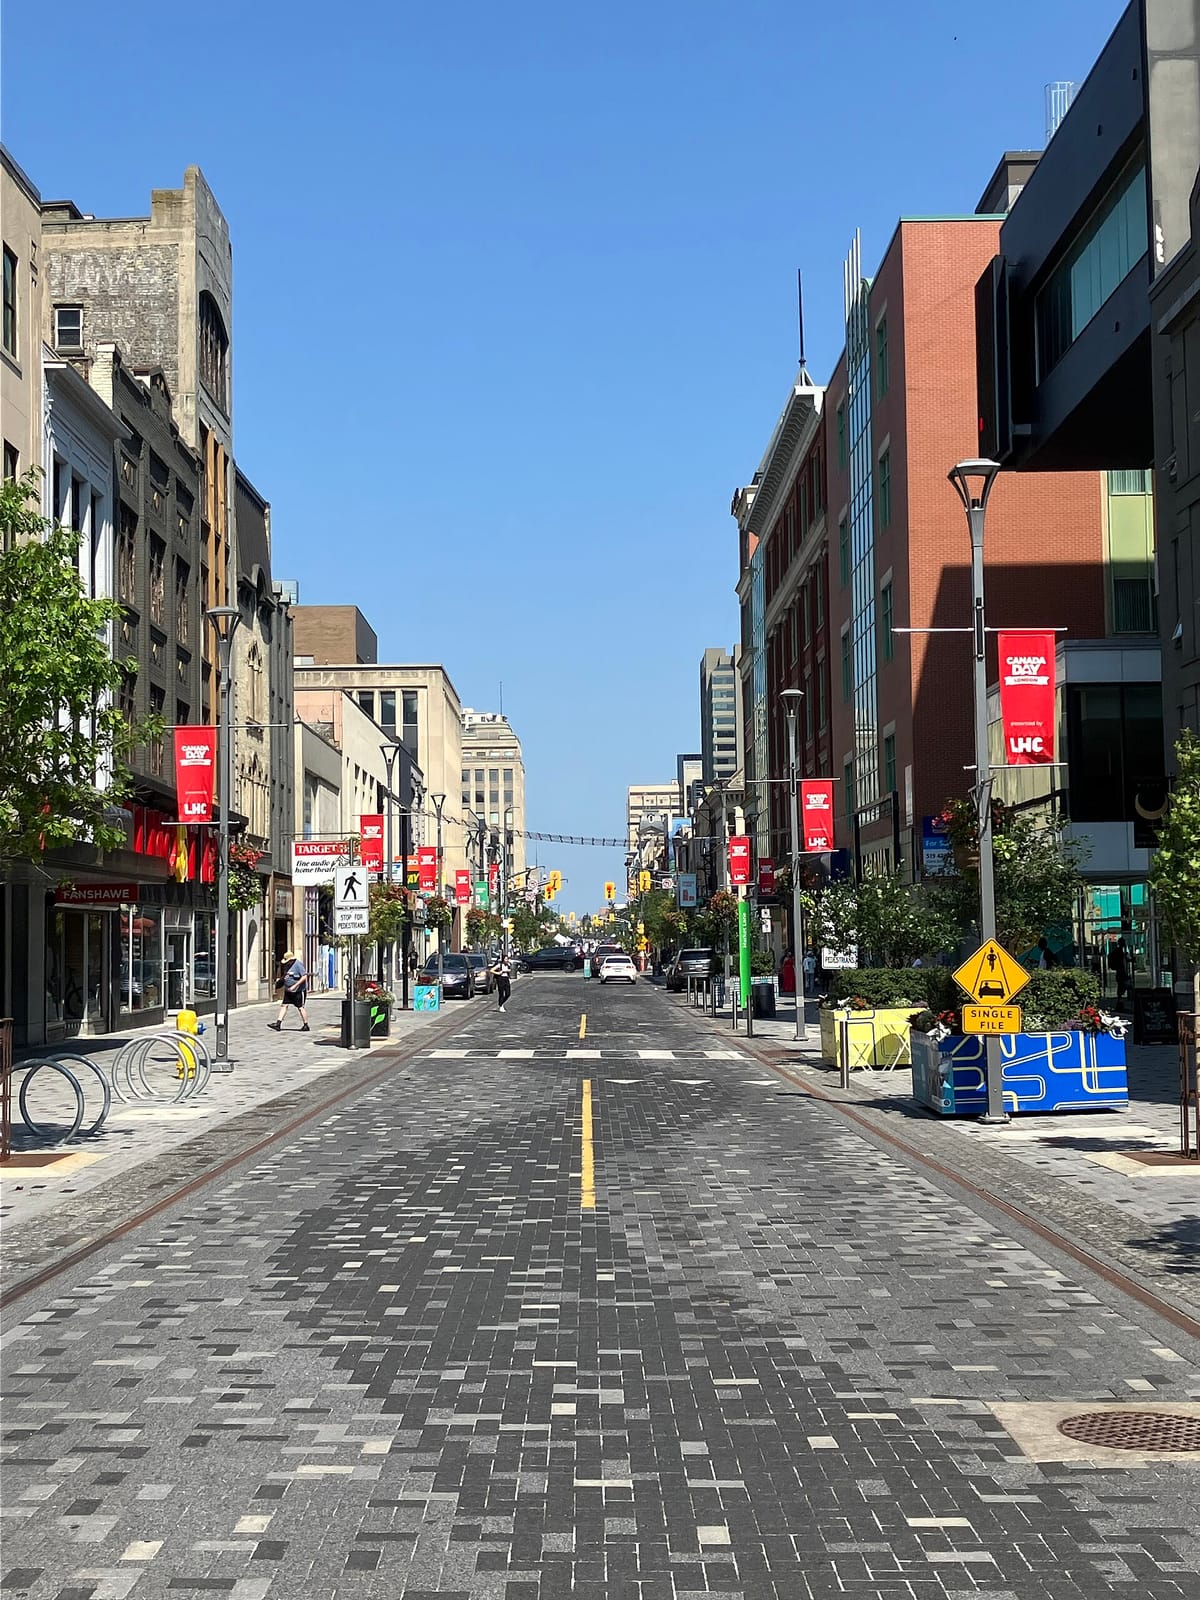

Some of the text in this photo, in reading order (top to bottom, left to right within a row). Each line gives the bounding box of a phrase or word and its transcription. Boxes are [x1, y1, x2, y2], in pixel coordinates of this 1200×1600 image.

[1006, 656, 1047, 664] CANADA
[1012, 664, 1040, 675] DAY
[1010, 737, 1044, 753] LHC
[185, 750, 207, 760] DAY
[183, 803, 208, 815] LHC
[808, 837, 828, 847] LHC
[296, 844, 338, 854] TARGET
[63, 889, 130, 899] FANSHAWE
[970, 1009, 1013, 1019] SINGLE
[980, 1021, 1004, 1030] FILE
